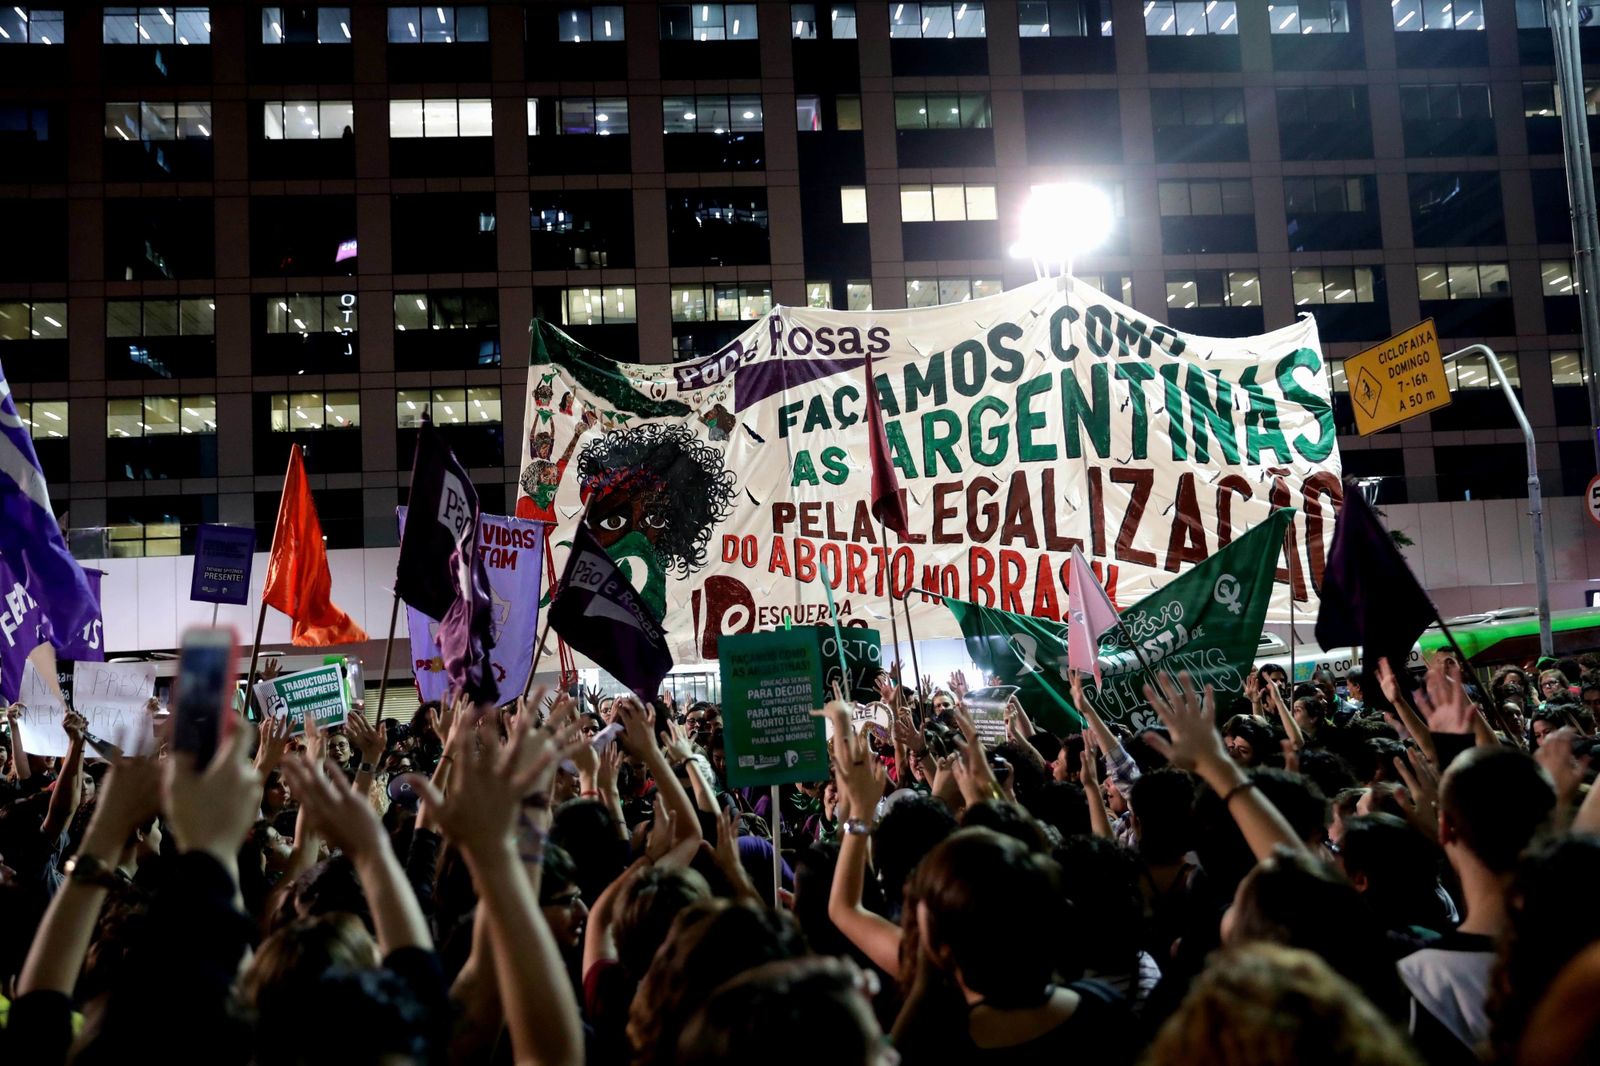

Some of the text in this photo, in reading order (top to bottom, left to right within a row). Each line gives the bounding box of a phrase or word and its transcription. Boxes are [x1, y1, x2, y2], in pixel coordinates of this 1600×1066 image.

[769, 315, 891, 357] Rosas
[1378, 330, 1434, 365] CICLOFAIXA
[778, 303, 1187, 439] FAÇAMOS COMO
[1388, 351, 1430, 379] DOMINGO
[1400, 389, 1436, 411] A 50 m
[791, 346, 1336, 487] AS ARGENTINAS
[772, 500, 877, 545] PELA
[483, 523, 535, 549] VIDAS
[479, 545, 518, 570] TAM
[721, 534, 759, 568] DO
[769, 535, 915, 601] ABORTO
[921, 563, 960, 606] NO
[204, 571, 244, 583] PRESENTE!
[571, 560, 660, 641] Pão e Rosas
[758, 599, 852, 626] ESQUERDA
[281, 671, 338, 692] TRADUCTORAS
[748, 688, 773, 700] PARA
[775, 683, 812, 697] DECIDIR
[285, 693, 293, 702] E
[291, 703, 342, 725] DE ABORTO
[747, 708, 770, 719] PARA
[751, 717, 784, 729] ABORTO
